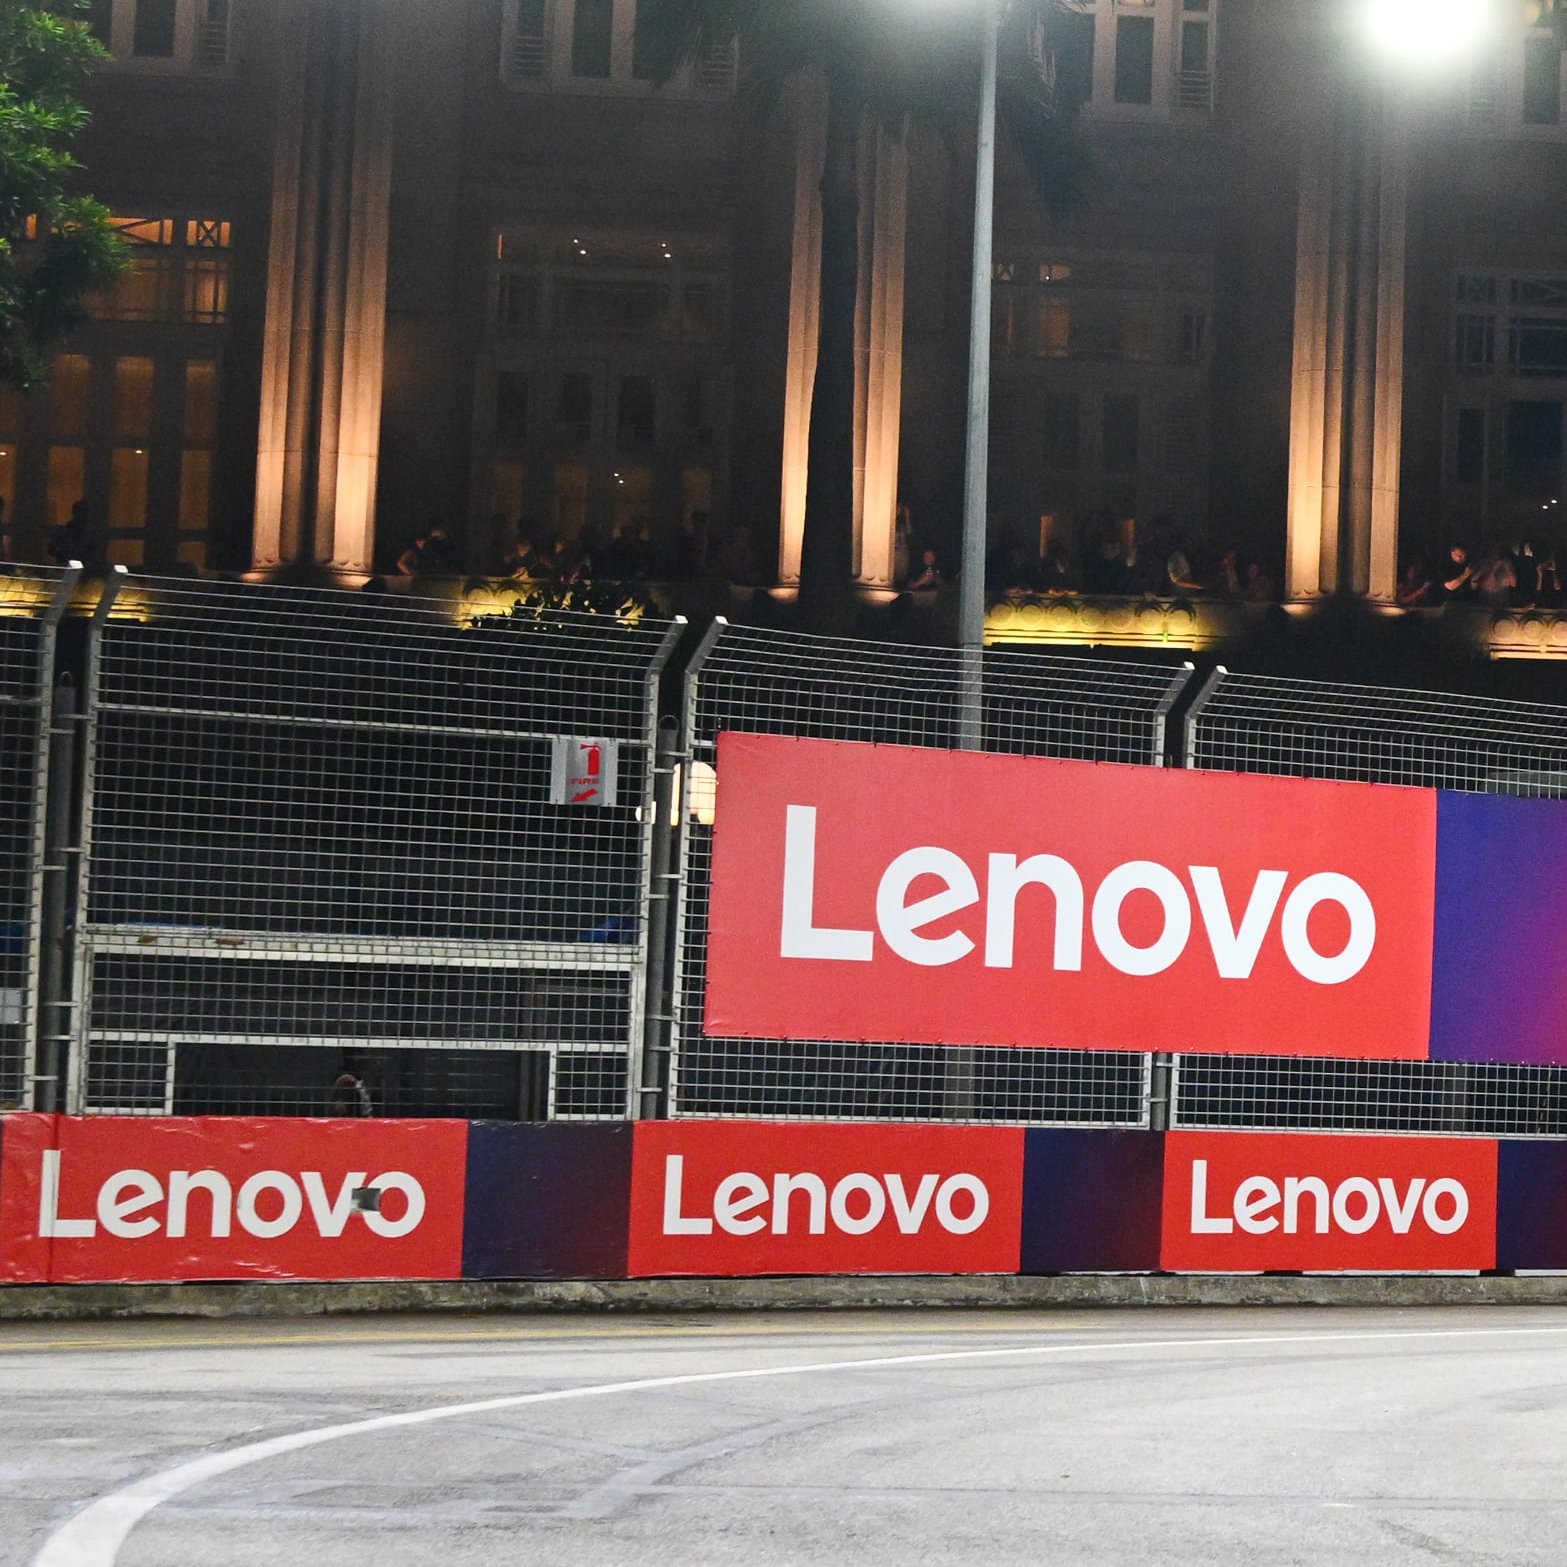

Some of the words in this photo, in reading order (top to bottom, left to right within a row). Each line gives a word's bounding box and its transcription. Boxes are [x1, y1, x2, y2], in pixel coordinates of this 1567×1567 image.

[779, 804, 1377, 985] Lenovo
[39, 1150, 426, 1238] Lenovo
[663, 1154, 990, 1235] Lenovo
[1190, 1159, 1470, 1235] Lenovo
